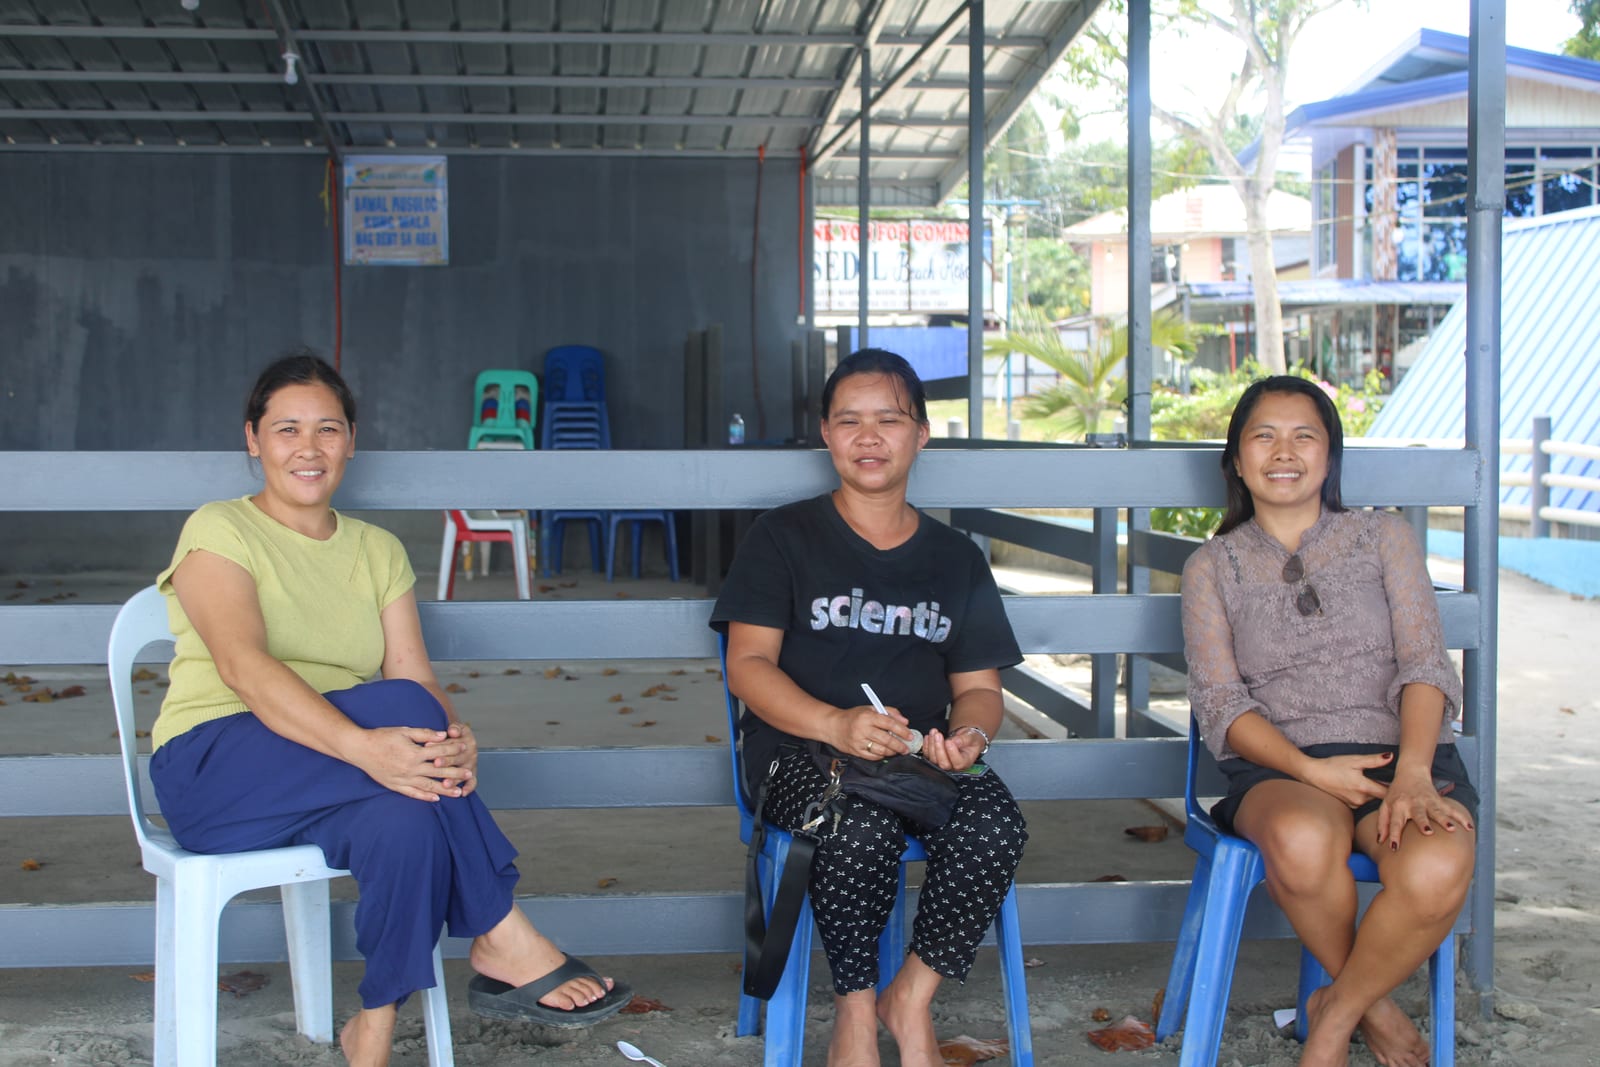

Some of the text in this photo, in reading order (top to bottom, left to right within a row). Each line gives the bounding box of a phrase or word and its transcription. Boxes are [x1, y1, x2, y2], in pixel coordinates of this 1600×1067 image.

[877, 222, 909, 241] FOR
[912, 222, 969, 241] COMIN
[810, 587, 952, 643] scientia
